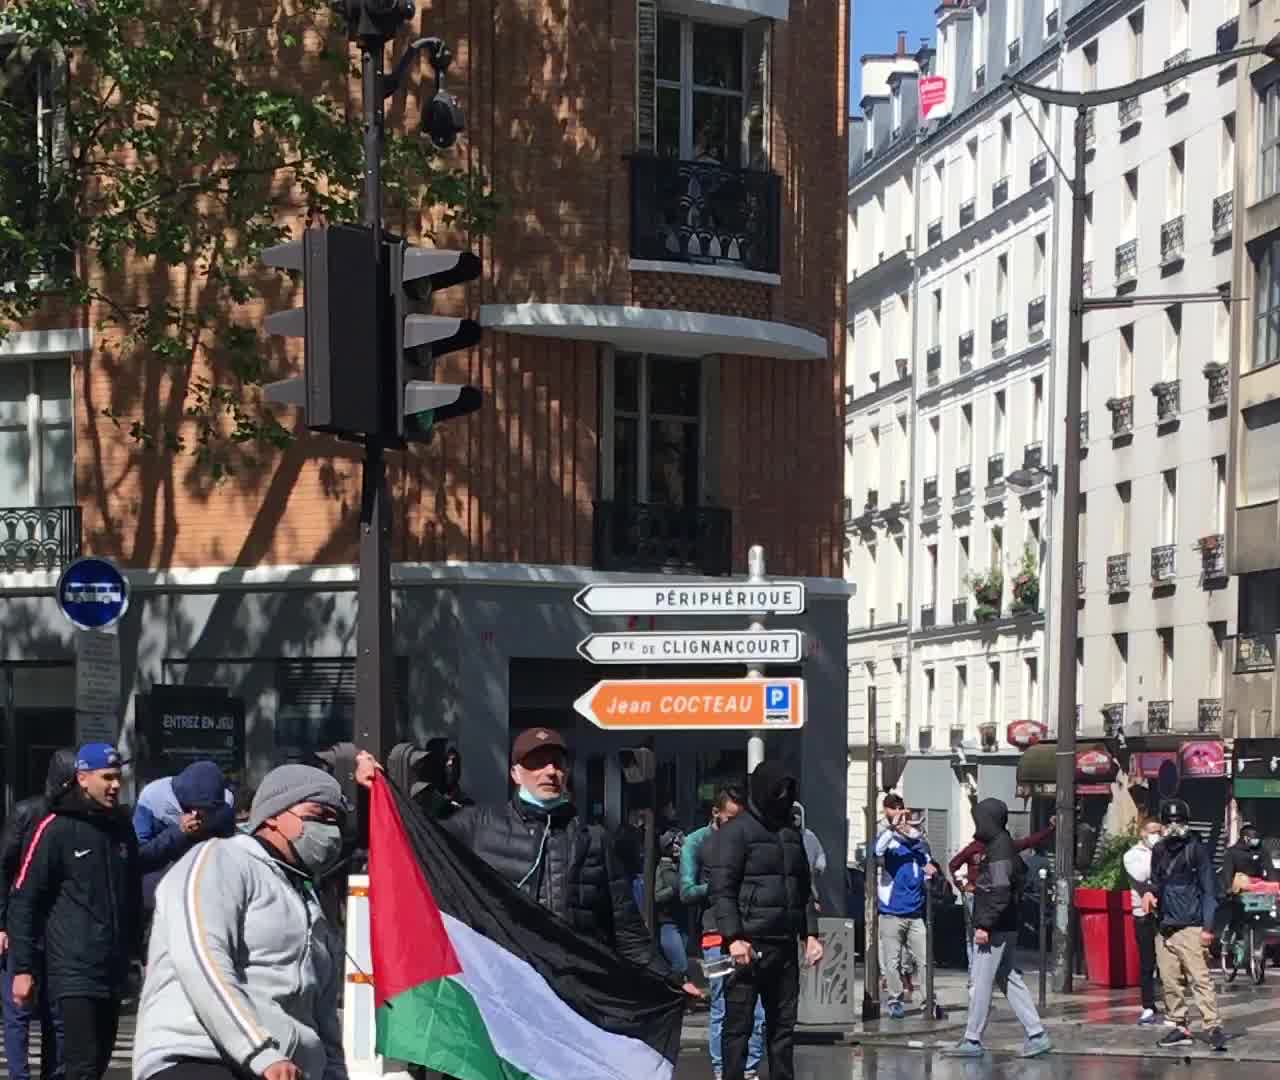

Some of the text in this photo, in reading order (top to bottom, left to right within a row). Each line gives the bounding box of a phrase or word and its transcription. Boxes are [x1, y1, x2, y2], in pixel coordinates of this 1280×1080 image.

[655, 589, 793, 605] PÉRIPHÉRIQUE
[641, 645, 656, 655] DE
[663, 639, 791, 655] CLIGNANCOURT
[606, 695, 753, 714] Jean COCTEAU
[771, 687, 784, 706] P
[163, 714, 200, 728] ENTREZ
[202, 715, 215, 728] EN
